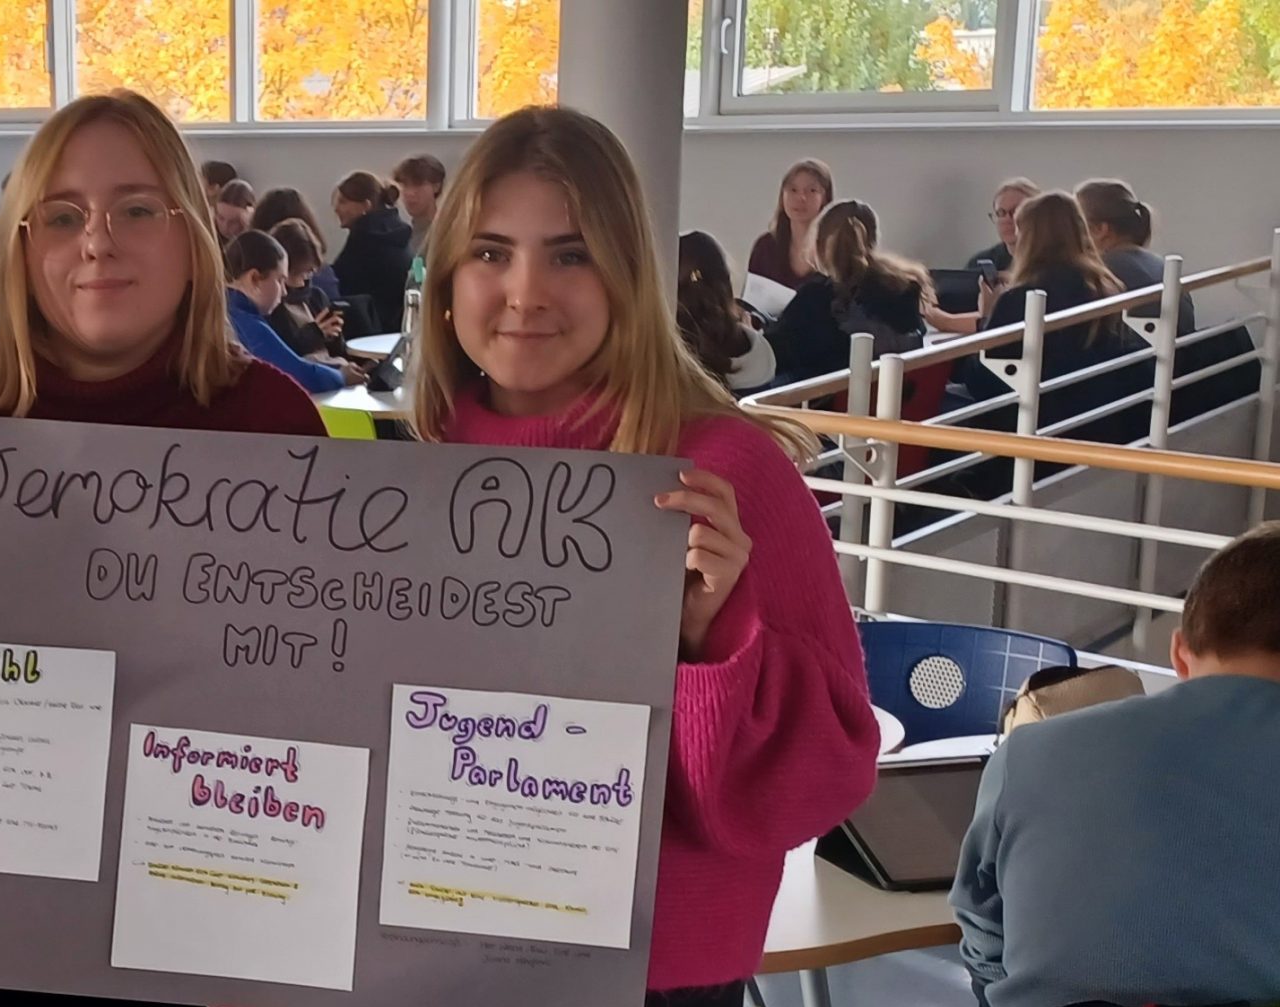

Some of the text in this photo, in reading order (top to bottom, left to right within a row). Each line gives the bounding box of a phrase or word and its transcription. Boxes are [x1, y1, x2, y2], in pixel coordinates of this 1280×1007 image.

[449, 456, 616, 573] AK
[86, 548, 572, 627] DU ENTSCHEIDEST
[144, 732, 298, 783] Informiert
[451, 746, 632, 806] Parlament
[191, 774, 325, 829] bleiben
